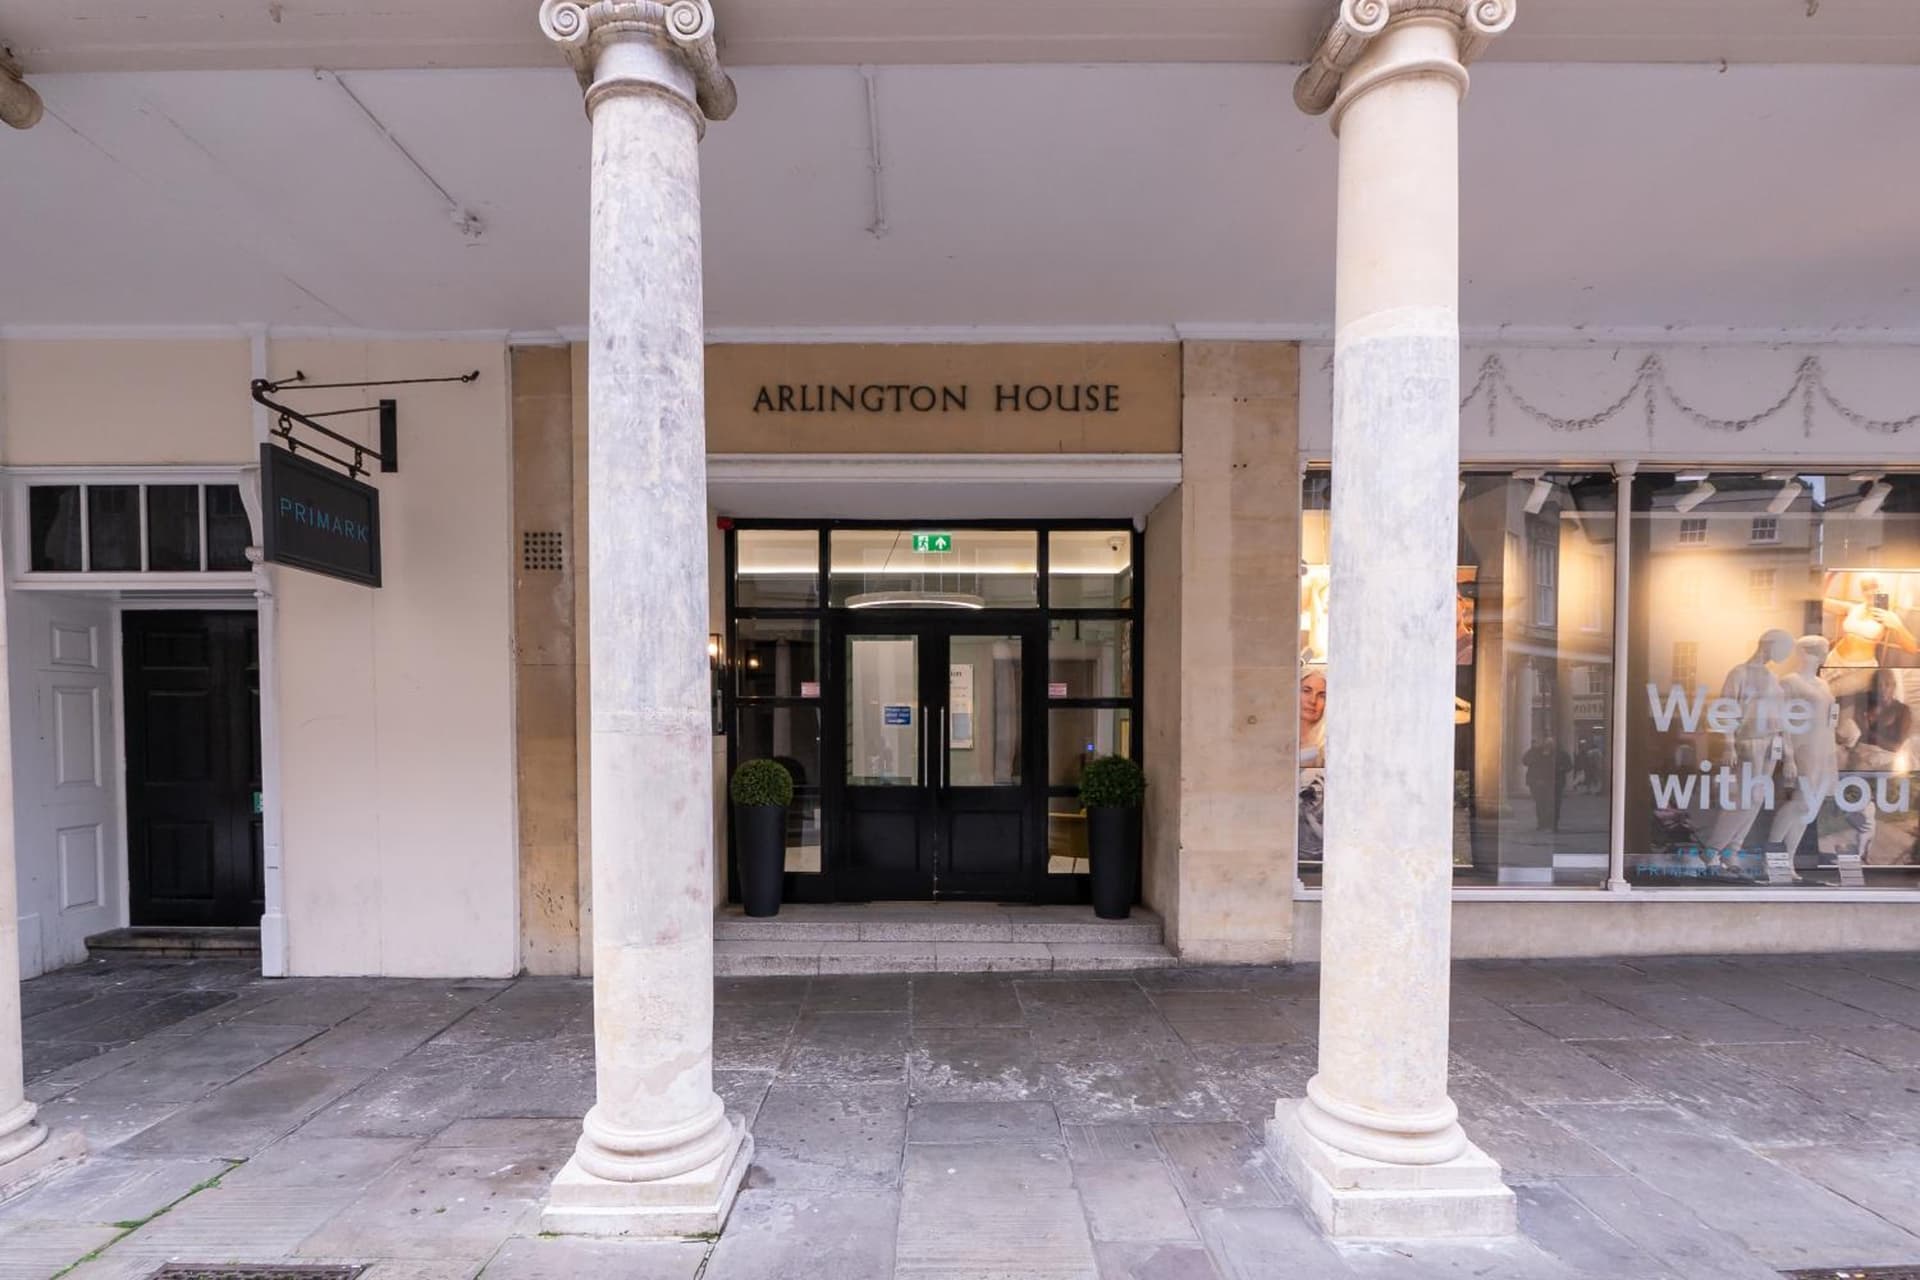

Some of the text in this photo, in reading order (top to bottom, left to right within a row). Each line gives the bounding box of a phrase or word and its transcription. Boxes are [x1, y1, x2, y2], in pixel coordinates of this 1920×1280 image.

[752, 384, 1120, 413] ARLINGTON HOUSE
[280, 497, 368, 542] PRIMARK
[1646, 683, 1813, 734] We're
[1649, 759, 1910, 826] with you
